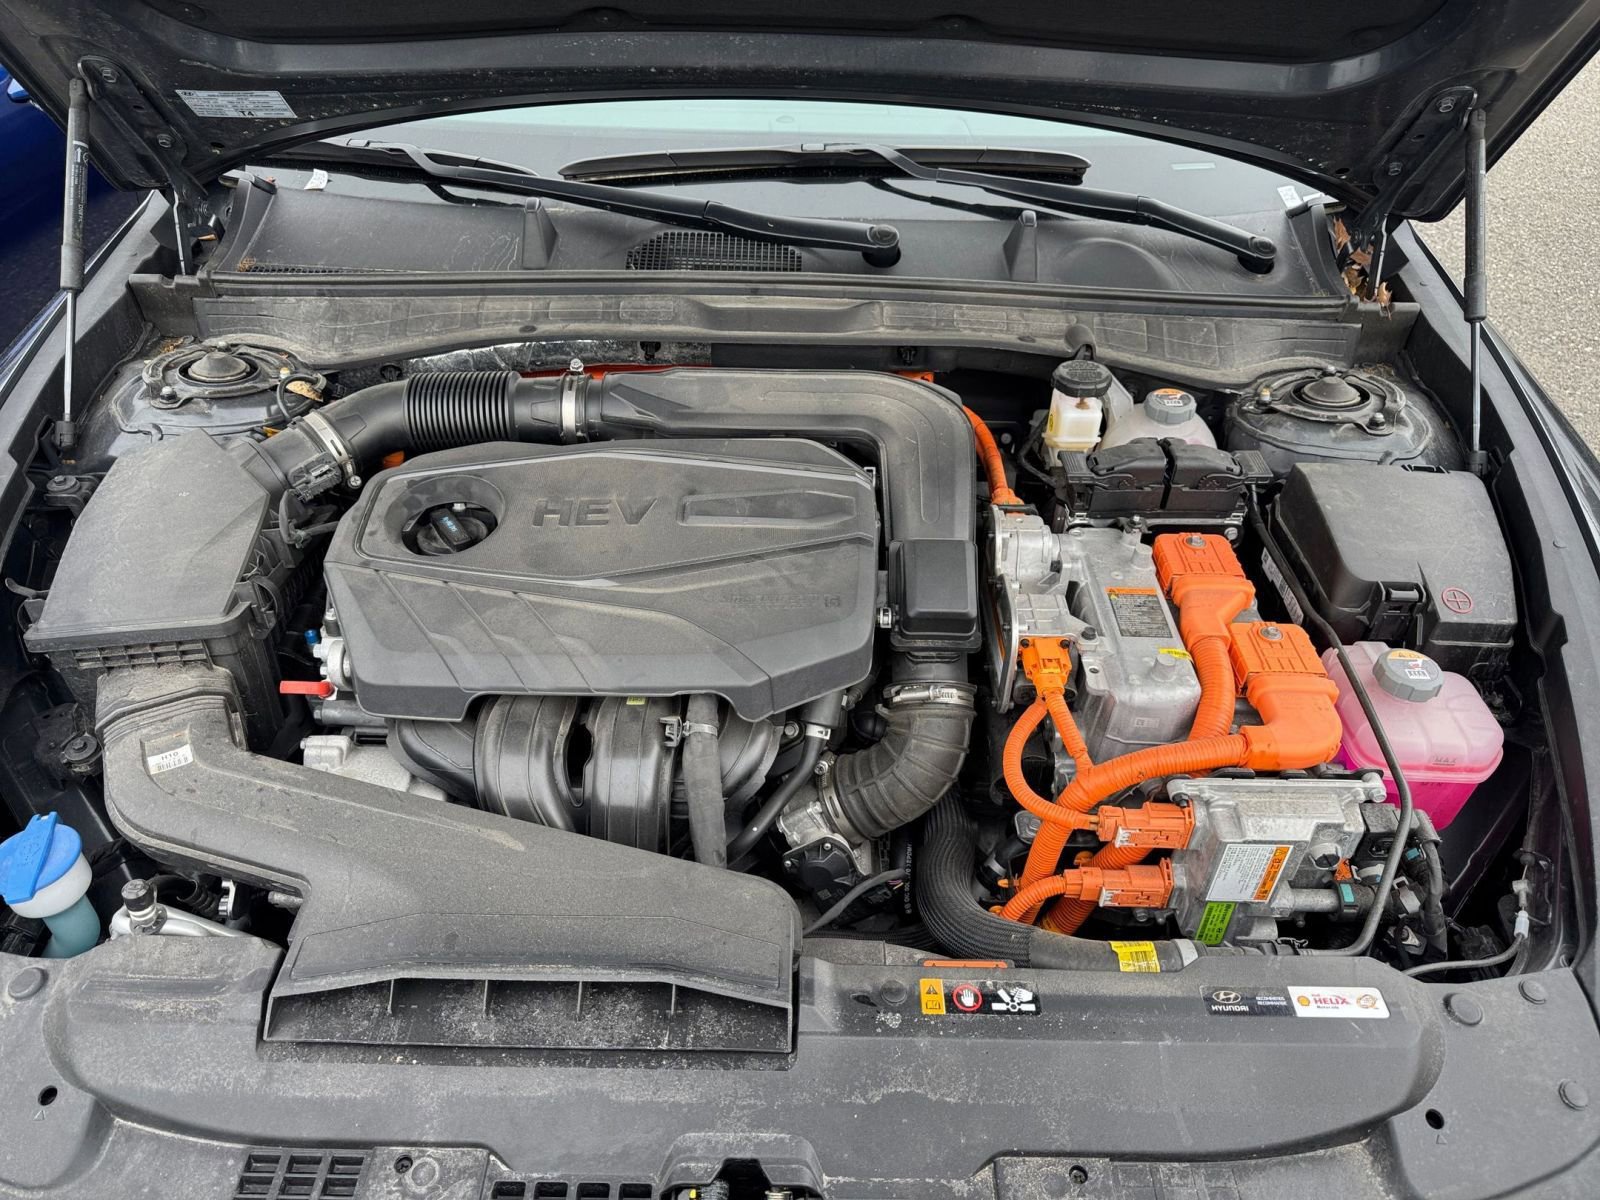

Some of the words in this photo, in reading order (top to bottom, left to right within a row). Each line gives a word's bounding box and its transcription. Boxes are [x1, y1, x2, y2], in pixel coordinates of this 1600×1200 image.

[532, 497, 657, 527] HEV
[161, 751, 179, 761] H10
[1313, 997, 1350, 1005] HELIX
